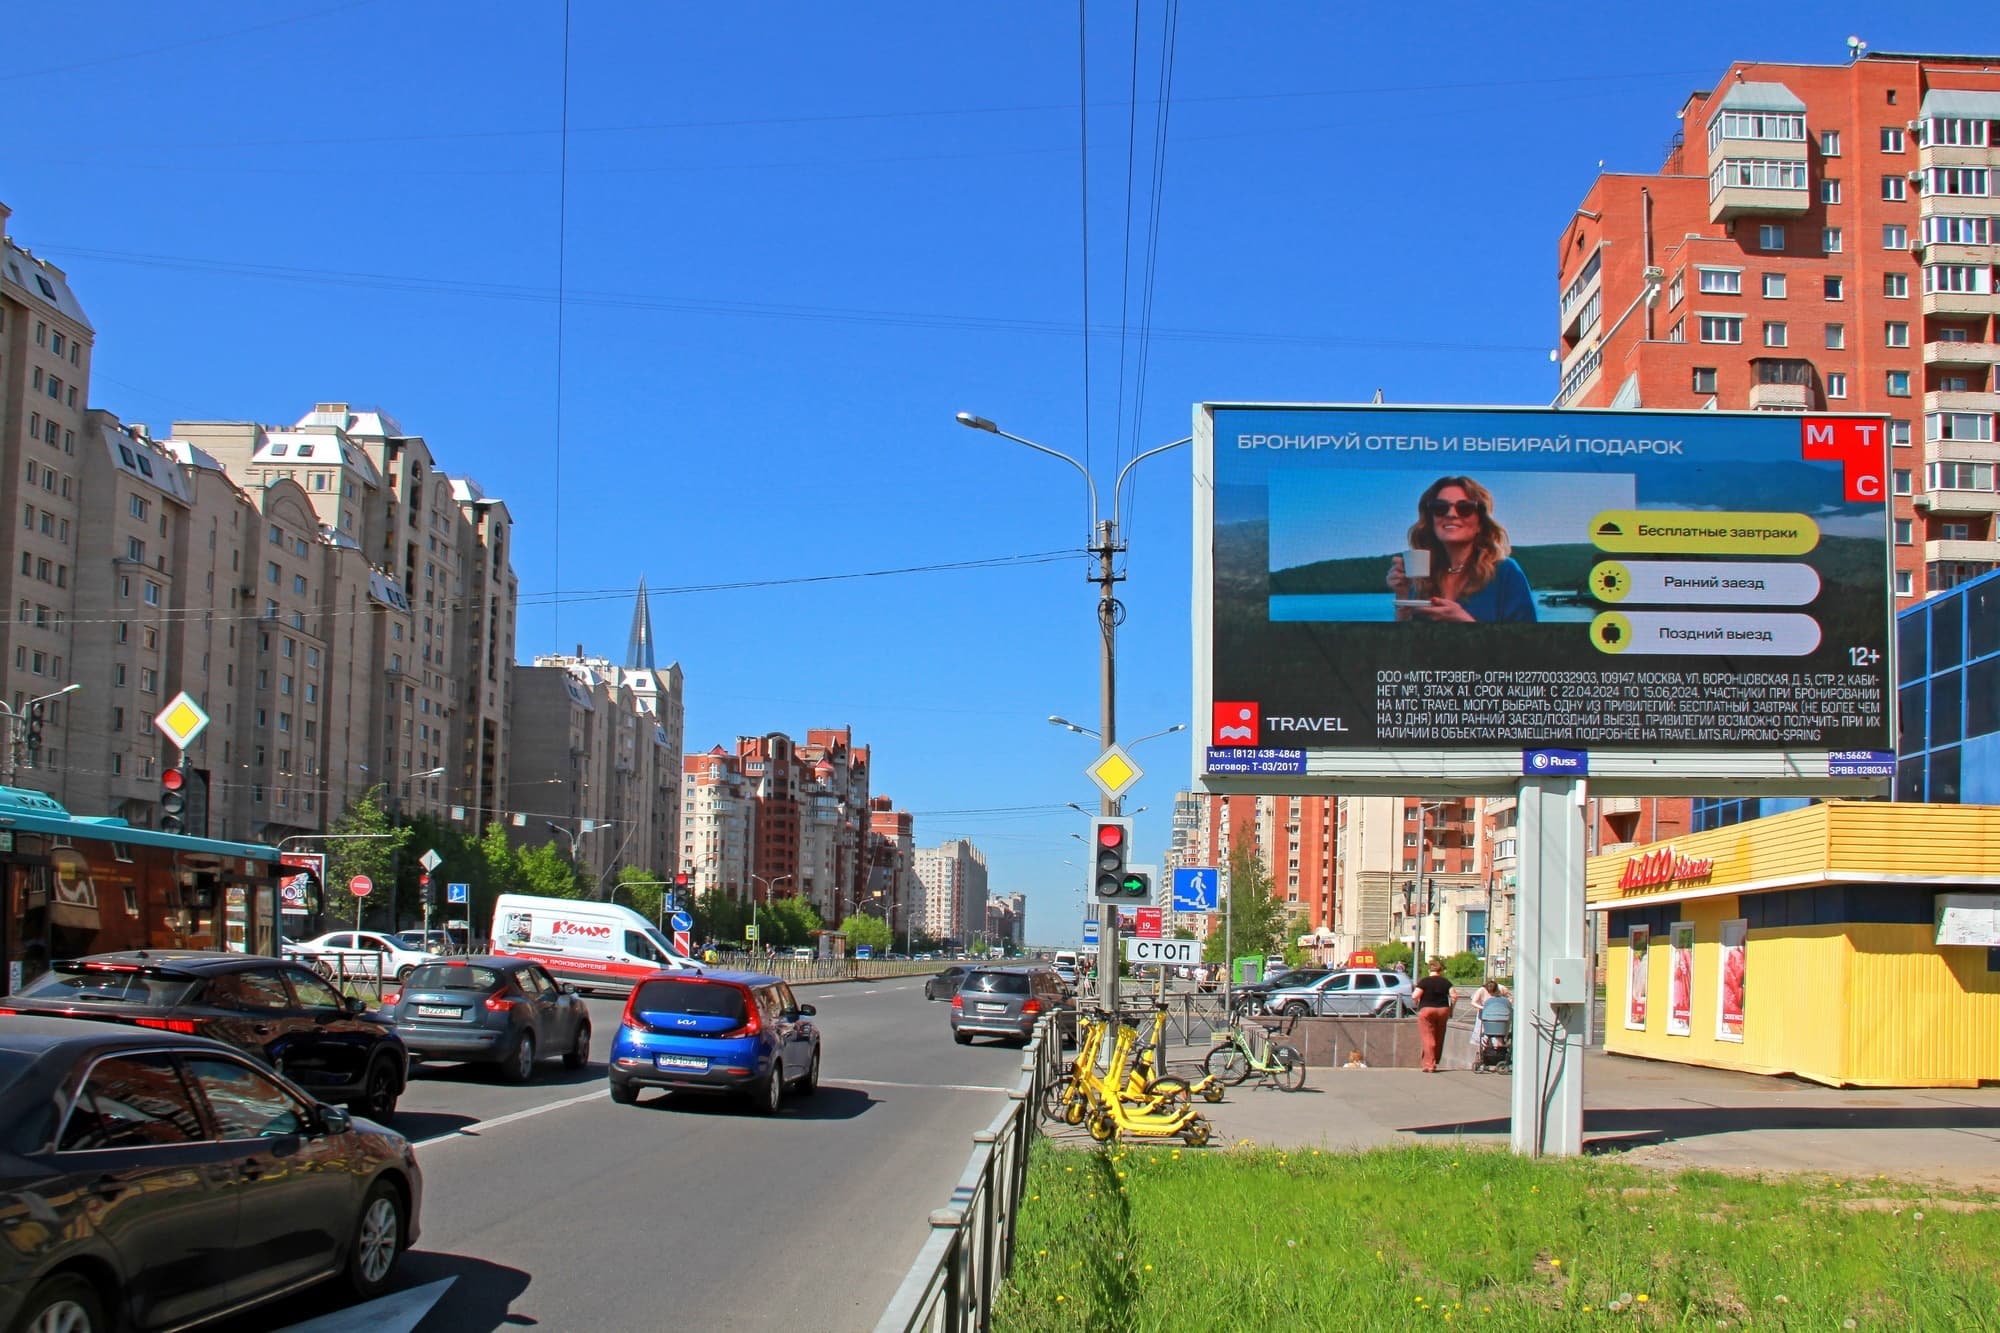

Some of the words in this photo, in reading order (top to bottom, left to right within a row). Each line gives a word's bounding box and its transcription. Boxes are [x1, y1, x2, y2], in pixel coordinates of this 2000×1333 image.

[1238, 432, 1361, 449] БРОНИРУЙ
[1365, 436, 1438, 451] ОТЕЛЬ
[1444, 437, 1458, 451] И
[1463, 435, 1571, 453] ВЫБИРАЙ
[1575, 439, 1683, 455] ПОДАРОК
[1638, 525, 1727, 538] Бесплатные
[1730, 527, 1797, 539] завтраки
[1664, 576, 1719, 588] Ранний
[1722, 579, 1764, 590] заезд
[1659, 628, 1723, 640] Поздний
[1727, 631, 1772, 641] выезд
[1848, 647, 1880, 666] 12+
[1377, 671, 1401, 682] ООО
[1404, 671, 1433, 683] «МТС
[1484, 672, 1512, 683] ОГРН
[1848, 675, 1879, 685] КАБИ-
[1377, 685, 1397, 696] НЕТ
[1424, 685, 1454, 696] ЭТАЖ
[1474, 686, 1503, 696] СРОК
[1508, 686, 1546, 698] АКЦИИ:
[1562, 686, 1619, 697] 22.04.2024
[1624, 686, 1639, 697] ПО
[1643, 686, 1700, 698] 15.06.2024.
[1703, 687, 1765, 699] УЧАСТНИКИ
[1770, 688, 1790, 699] ПРИ
[1795, 689, 1879, 699] БРОНИРОВАНИИ
[1377, 699, 1392, 710] НА
[1395, 699, 1418, 710] МТС
[1422, 699, 1460, 710] TRAVEL
[1464, 700, 1499, 711] МОГУТ
[1503, 700, 1550, 711] ВЫБРАТЬ
[1554, 700, 1583, 712] ОДНУ
[1587, 700, 1600, 711] ИЗ
[1680, 699, 1749, 712] БЕСПЛАТНЫЙ
[1753, 702, 1798, 713] ЗАВТРАК
[1801, 701, 1818, 713] (НЕ
[1822, 702, 1855, 713] БОЛЕЕ
[1858, 702, 1879, 713] ЧЕМ
[1266, 718, 1349, 731] TRAVEL
[1377, 713, 1392, 724] НА
[1395, 713, 1402, 724] 3
[1405, 713, 1431, 726] ДНЯ)
[1435, 713, 1457, 724] ИЛИ
[1462, 711, 1505, 725] РАННИЙ
[1646, 715, 1714, 726] ПРИВИЛЕГИИ
[1718, 716, 1780, 727] ВОЗМОЖНО
[1784, 716, 1838, 727] ПОЛУЧИТЬ
[1842, 716, 1862, 727] ПРИ
[1866, 717, 1880, 727] ИХ
[1377, 727, 1429, 738] НАЛИЧИИ
[1432, 728, 1439, 738] В
[1441, 728, 1495, 739] ОБЪЕКТАХ
[1576, 728, 1640, 740] ПОДРОБНЕЕ
[1642, 728, 1656, 739] НА
[1234, 749, 1255, 758] (812)
[1258, 750, 1300, 758] 438-4848
[1209, 763, 1249, 772] договор:
[1550, 757, 1576, 766] Russ
[1137, 942, 1190, 960] СТОП
[549, 959, 607, 971] ПРОИЗВОДИТЕЛЕЙ
